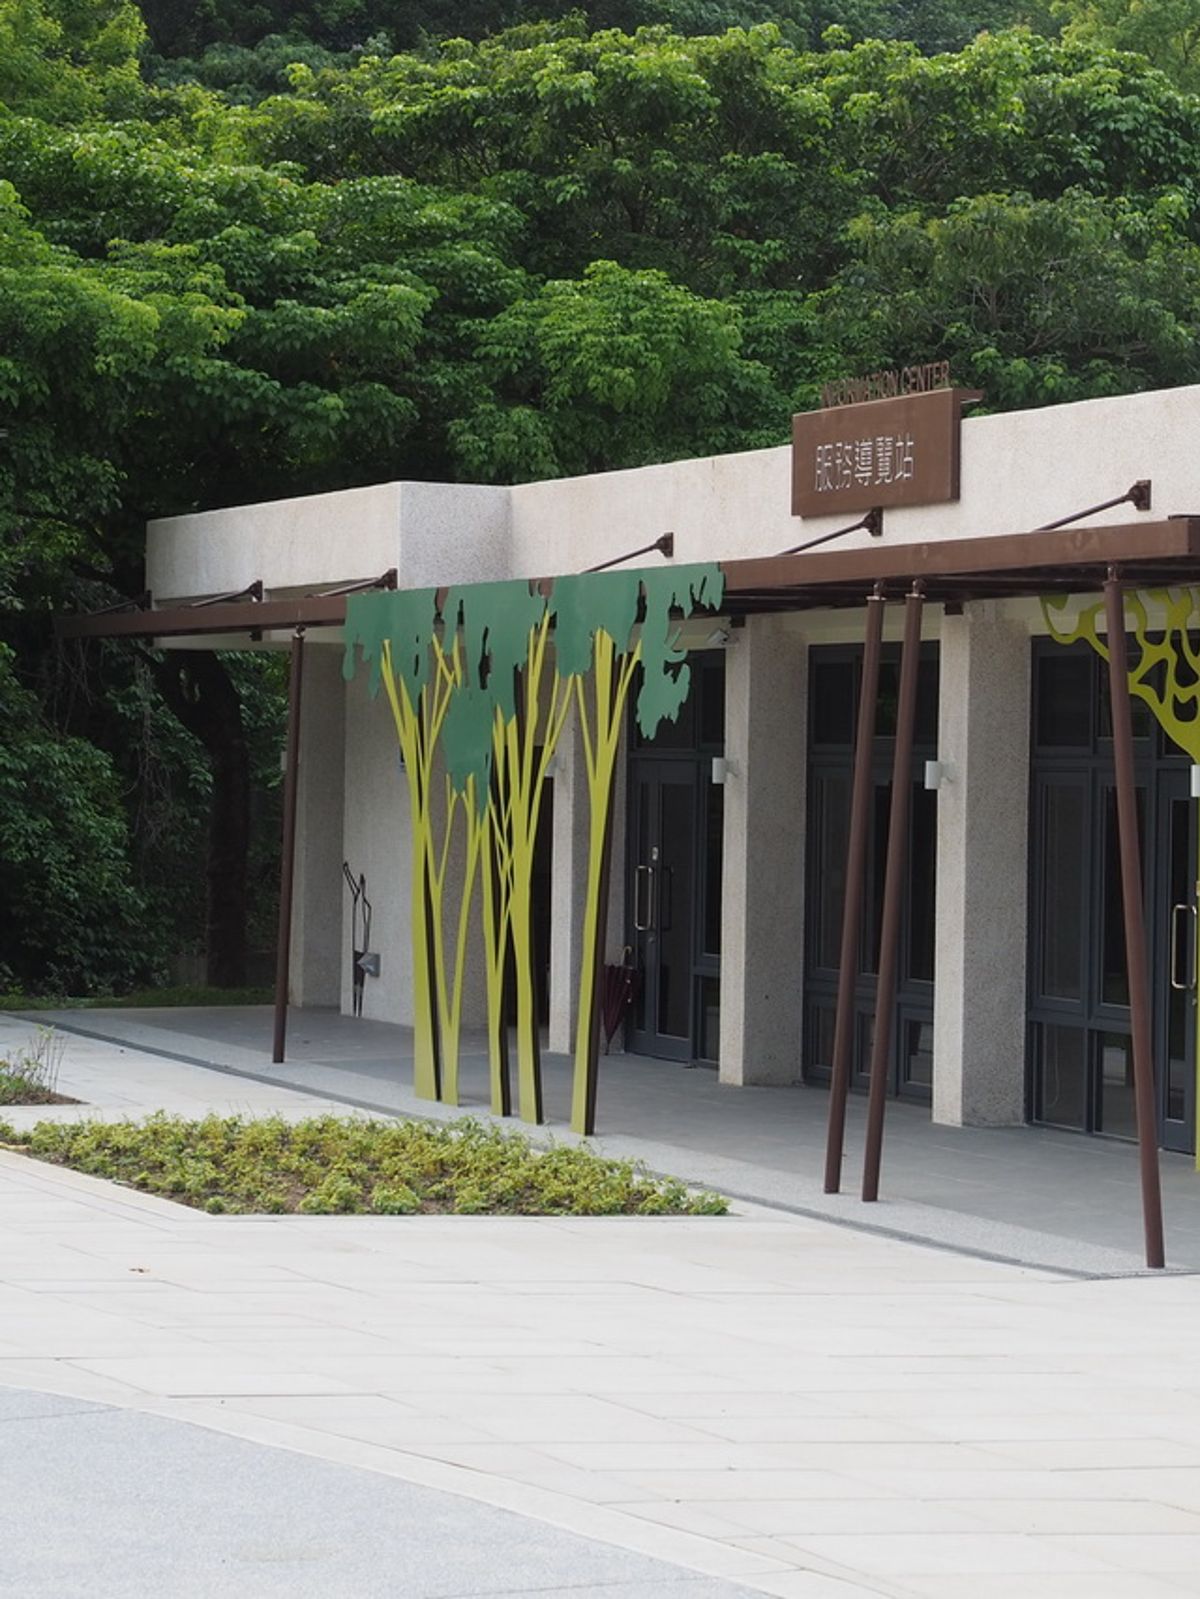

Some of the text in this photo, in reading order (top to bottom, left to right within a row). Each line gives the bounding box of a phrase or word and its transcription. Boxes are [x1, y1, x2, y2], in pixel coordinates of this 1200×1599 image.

[901, 360, 950, 395] CENTER
[815, 433, 914, 492] 服務導覽站
